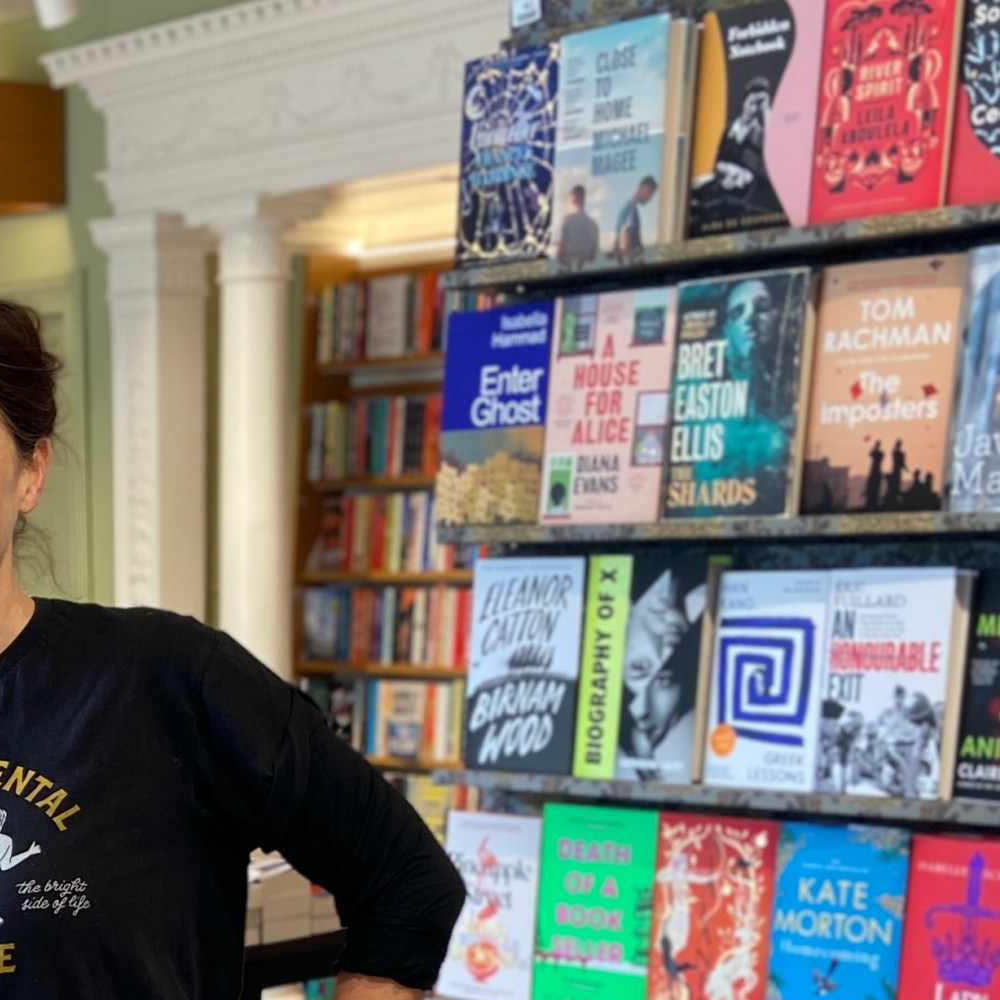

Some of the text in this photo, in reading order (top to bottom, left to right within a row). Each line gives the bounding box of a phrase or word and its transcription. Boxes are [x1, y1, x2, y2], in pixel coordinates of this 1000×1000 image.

[727, 18, 791, 42] Forbidden
[596, 45, 637, 73] CLOSE
[727, 36, 786, 60] Notebook
[858, 60, 903, 81] RIVER
[595, 78, 613, 98] TO
[855, 78, 903, 101] SPIRIT
[592, 96, 633, 125] HOME
[857, 106, 896, 126] LEILA
[592, 122, 650, 150] MICHAEL
[590, 149, 637, 178] MAGEE
[500, 310, 548, 331] Isabella
[859, 296, 916, 322] TOM
[490, 328, 548, 349] Hammad
[602, 334, 615, 359] A
[822, 322, 953, 355] RACHMAN
[573, 360, 642, 389] HOUSE
[677, 339, 729, 381] BRET
[480, 363, 544, 397] Enter
[858, 371, 901, 394] The
[470, 394, 542, 428] Ghost
[585, 390, 622, 416] FOR
[674, 380, 749, 422] EASTON
[820, 398, 939, 428] Imposters
[571, 418, 631, 445] ALICE
[671, 423, 725, 463] ELLIS
[576, 454, 620, 474] DIANA
[573, 473, 619, 496] EVANS
[667, 478, 757, 508] SHARDS
[480, 573, 574, 624] ELEANOR
[480, 607, 562, 657] CATTON
[832, 610, 857, 640] AN
[584, 567, 618, 766] BIOGRAPHY OF X
[829, 641, 943, 674] HONOURABLE
[828, 673, 865, 702] EXIT
[469, 679, 567, 734] BIRNAM
[478, 713, 553, 766] WOOD
[556, 836, 634, 867] DEATH
[15, 877, 87, 901] the bright
[563, 870, 620, 899] OF A
[797, 876, 870, 911] KATE
[20, 894, 91, 916] side of life
[554, 901, 624, 933] BOOK
[773, 907, 894, 947] MORTON
[550, 933, 625, 965] SELLER
